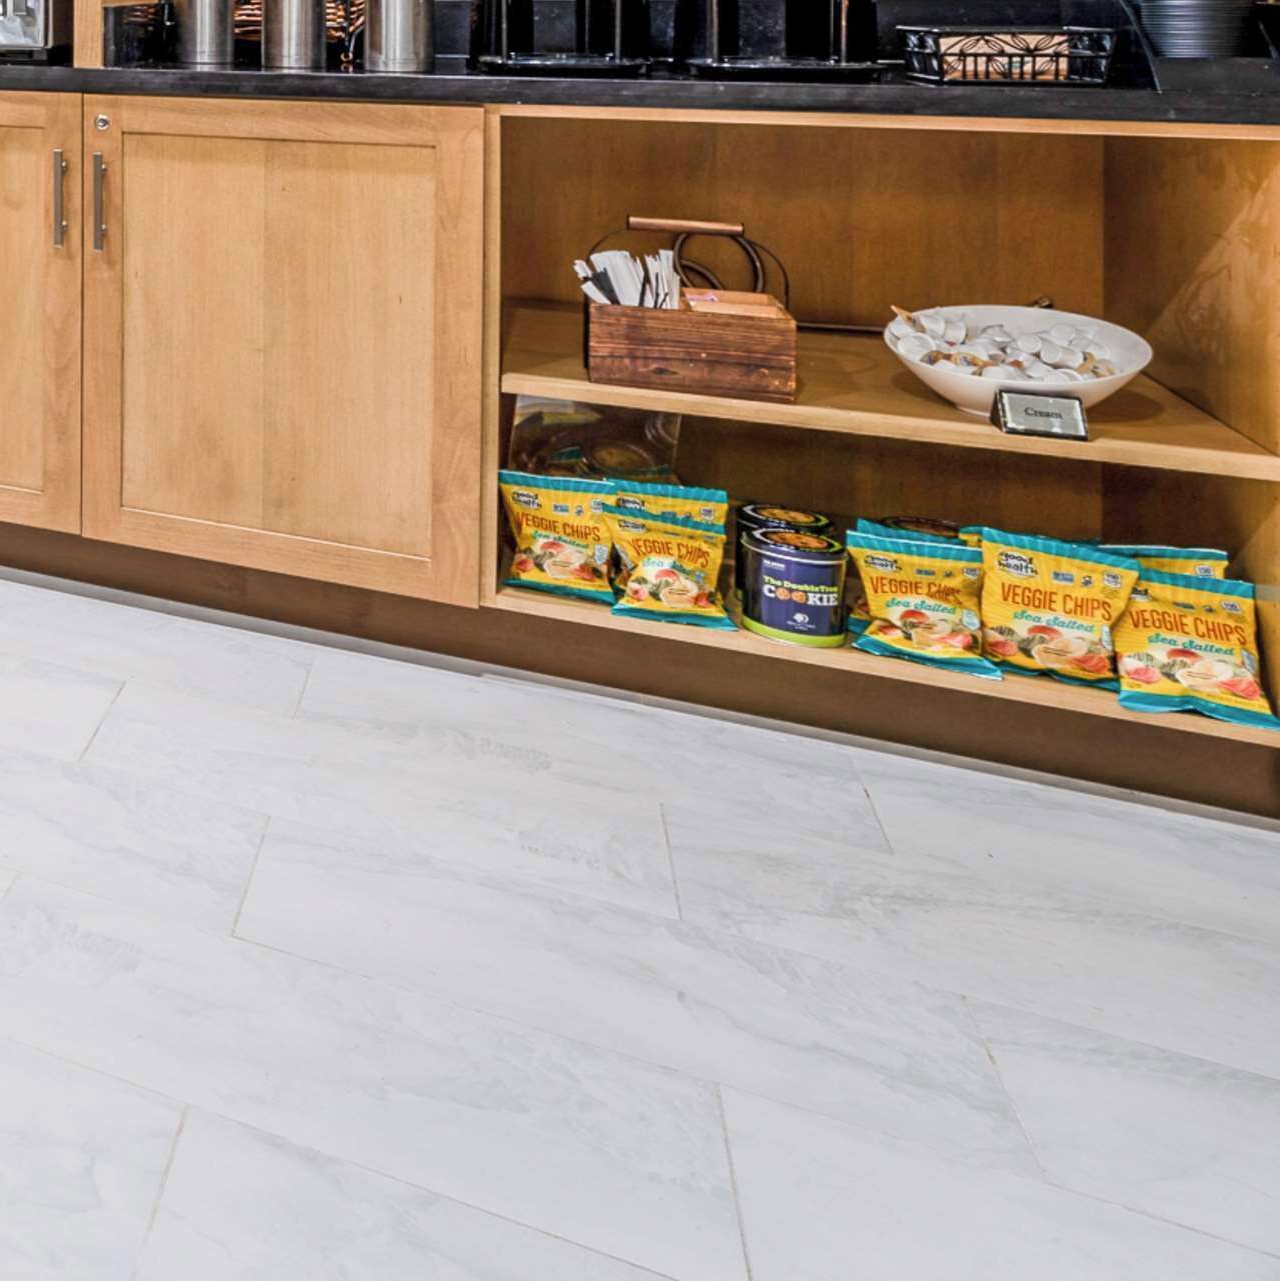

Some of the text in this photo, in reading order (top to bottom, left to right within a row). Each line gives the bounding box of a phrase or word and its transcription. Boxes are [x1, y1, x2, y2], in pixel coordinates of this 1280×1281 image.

[1024, 406, 1063, 419] Cream
[517, 511, 601, 542] VEGGIE CHIPS
[630, 538, 711, 569] VEGGIE CHIPS
[763, 575, 783, 587] The
[869, 575, 922, 596] VEGGIE
[763, 584, 839, 607] COOKIE
[1001, 581, 1113, 622] VEGGIE CHIPS
[1012, 609, 1095, 634] Sea Salted
[1128, 608, 1248, 646] VEGGIE CHIPS
[1147, 632, 1235, 657] Sea Salted
